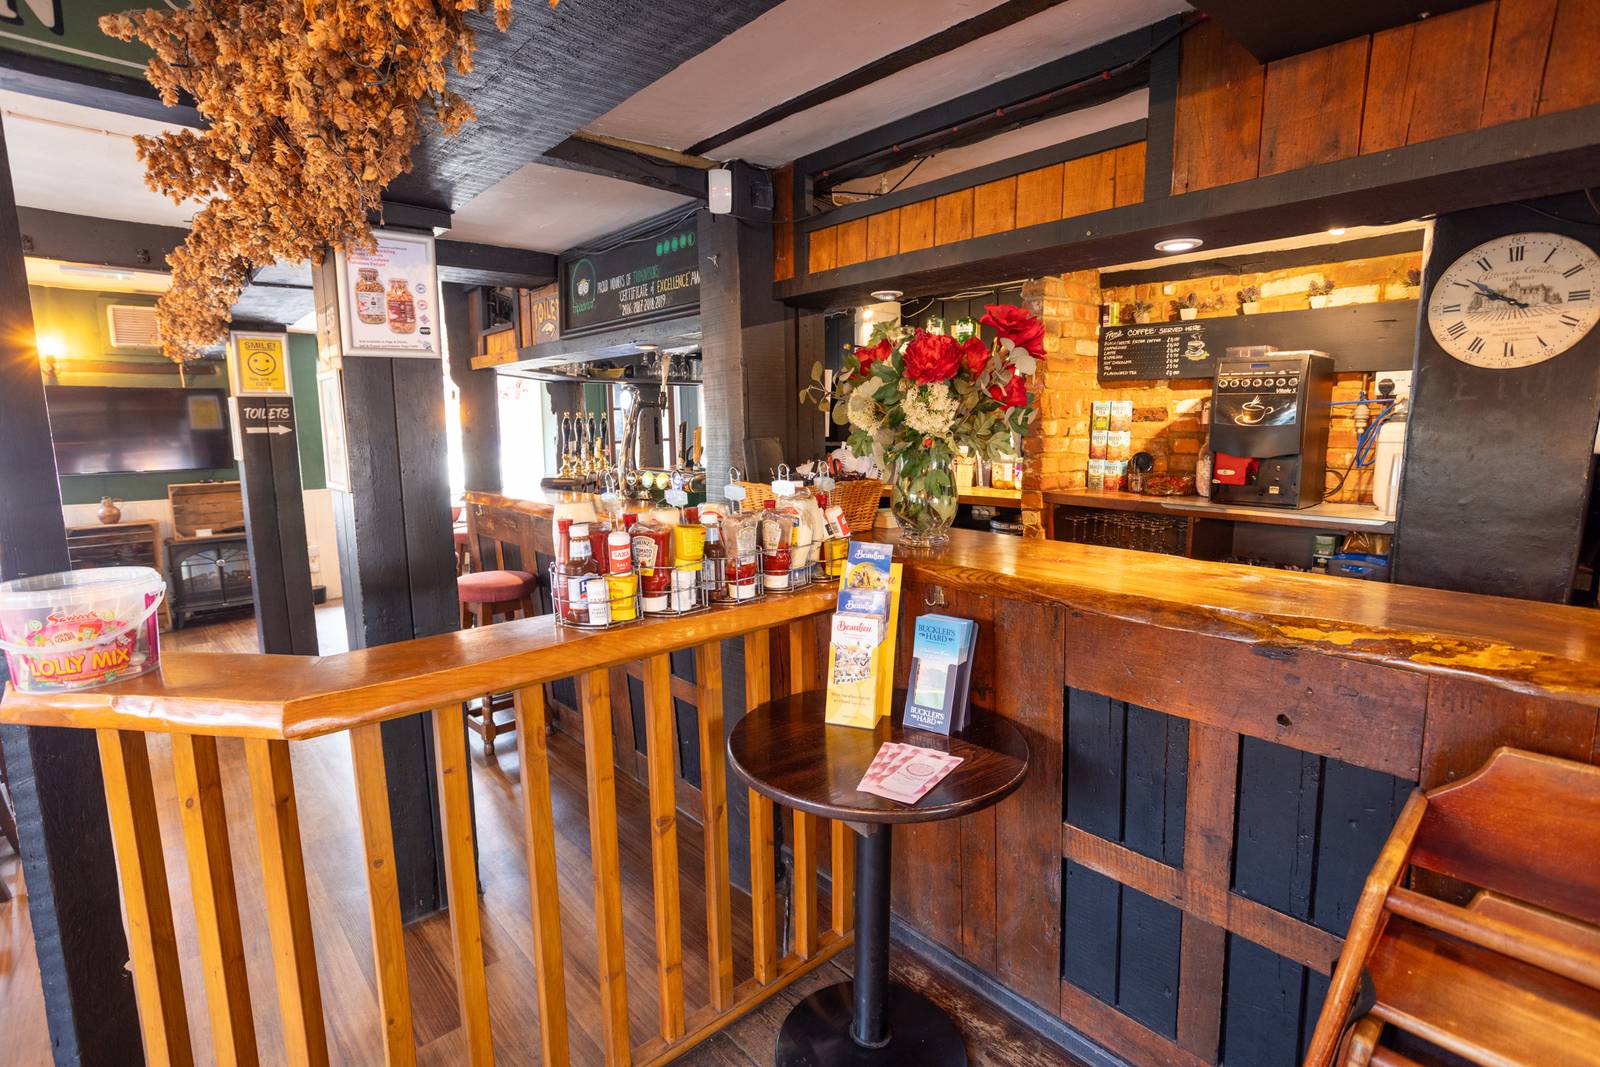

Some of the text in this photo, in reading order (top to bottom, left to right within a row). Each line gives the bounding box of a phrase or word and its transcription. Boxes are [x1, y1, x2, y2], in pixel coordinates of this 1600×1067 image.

[1127, 328, 1155, 337] COFFEE
[243, 407, 290, 420] TOILETS
[925, 631, 948, 642] HARD
[31, 654, 86, 677] LOLLY
[92, 647, 130, 670] MIX
[916, 715, 937, 726] HARD
